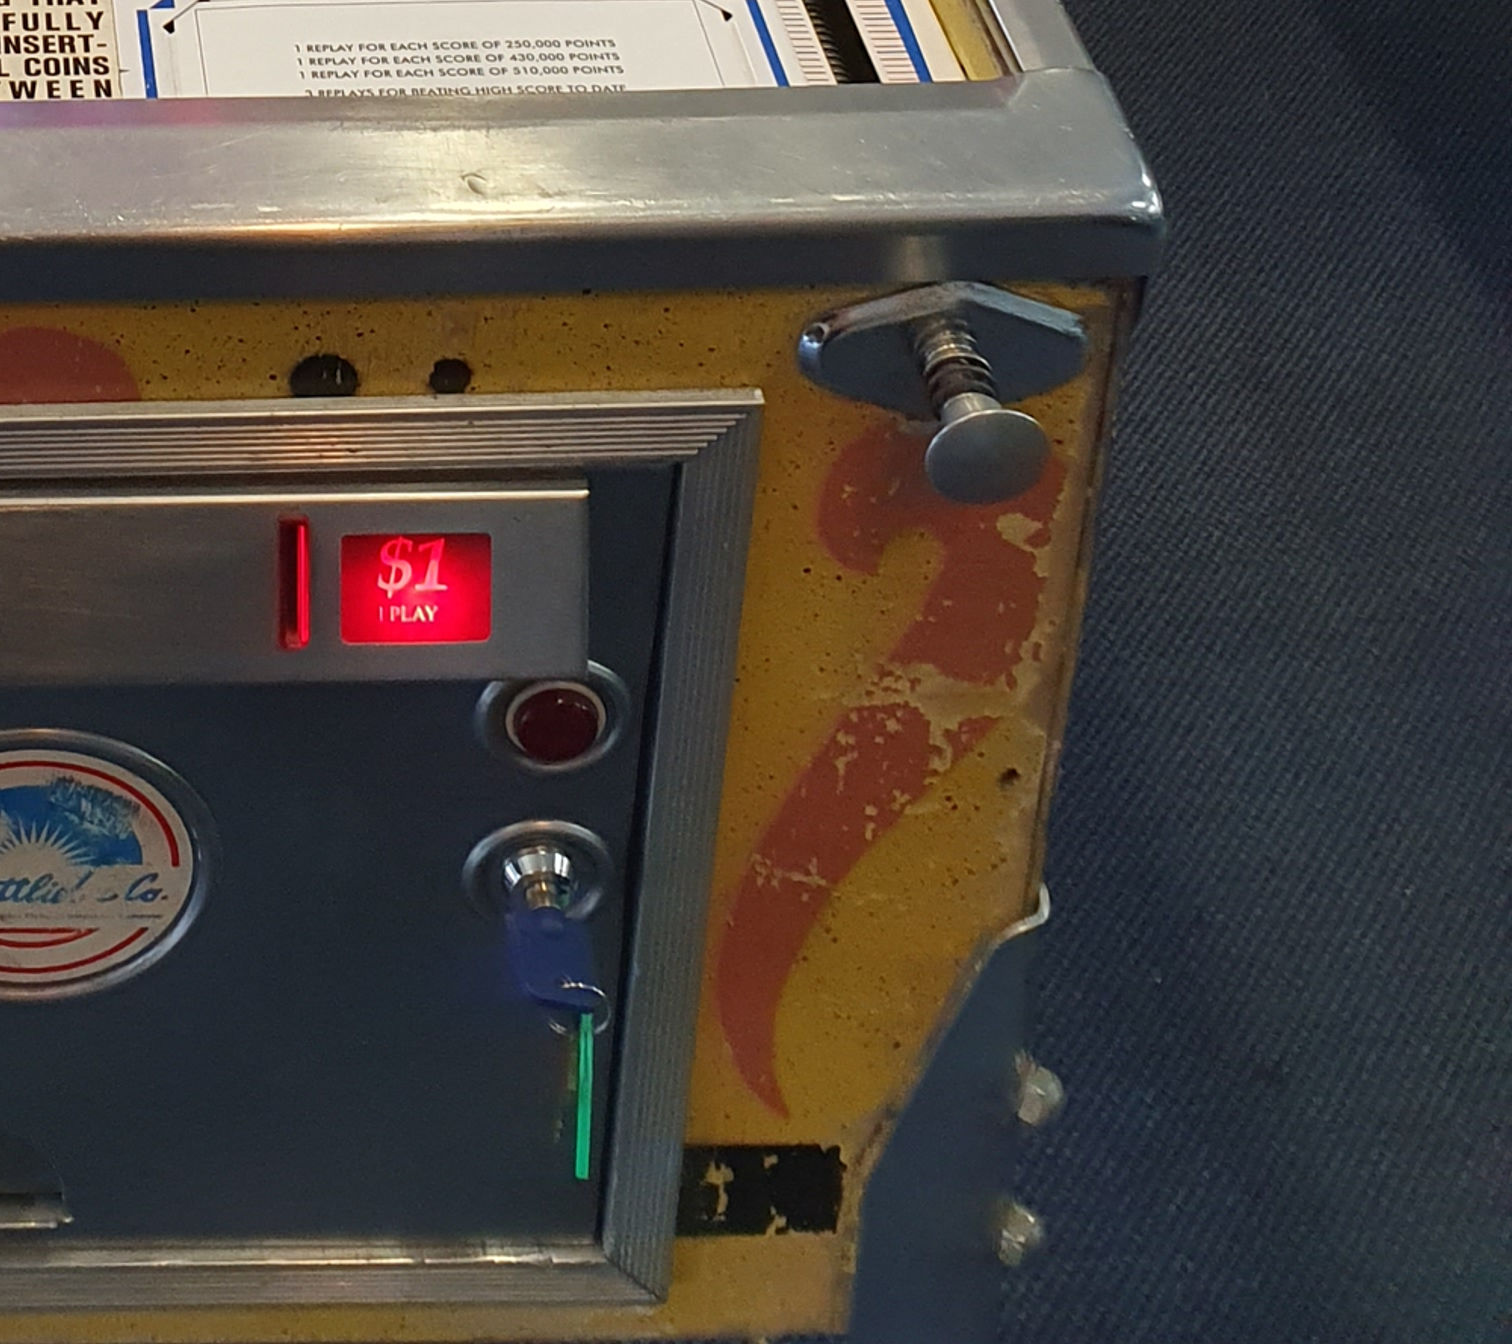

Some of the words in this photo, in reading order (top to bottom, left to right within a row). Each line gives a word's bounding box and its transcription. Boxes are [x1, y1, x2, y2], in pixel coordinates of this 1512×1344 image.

[2, 11, 104, 31] FULLY
[306, 43, 353, 53] REPLAY
[358, 43, 388, 52] FOR
[390, 42, 428, 51] EACH
[432, 41, 478, 51] SCORE
[481, 40, 501, 50] OF
[504, 39, 561, 50] 250,000
[565, 39, 617, 48] POINTS
[23, 56, 110, 76] COINS
[377, 535, 448, 599] $1
[390, 605, 438, 622] PLAY
